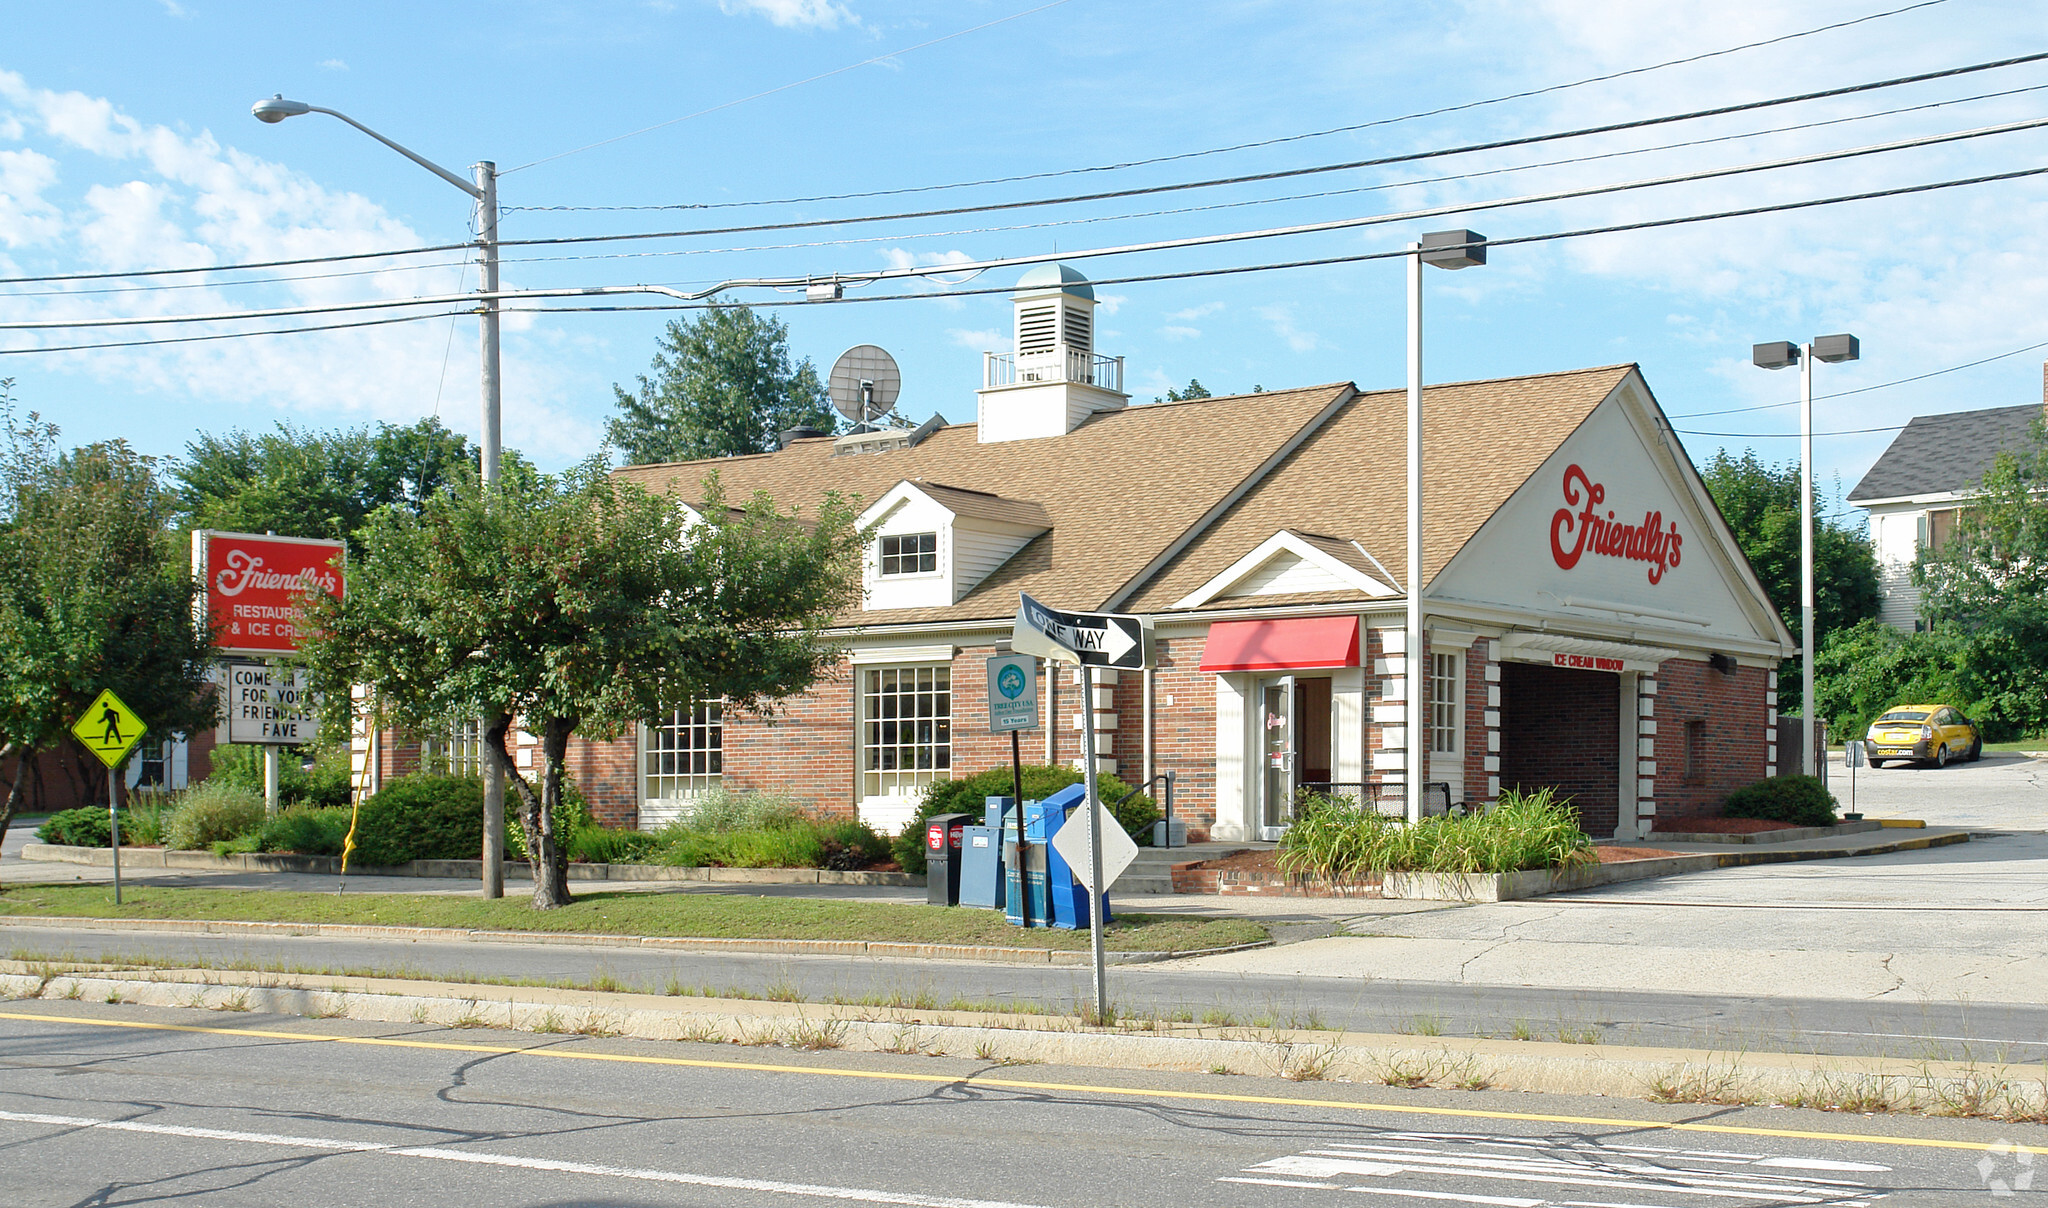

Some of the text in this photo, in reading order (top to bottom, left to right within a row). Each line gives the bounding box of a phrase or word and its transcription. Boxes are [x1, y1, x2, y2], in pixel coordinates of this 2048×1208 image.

[1550, 463, 1683, 585] Friendly's
[216, 549, 337, 601] Friendly's
[233, 604, 304, 620] RESTAURA
[231, 622, 241, 635] &
[248, 623, 270, 636] ICE
[1036, 612, 1105, 649] ONE WAY
[1554, 653, 1624, 671] ICE CREAM WINDOW
[236, 671, 271, 686] COME
[242, 688, 268, 703] FOR
[262, 723, 297, 737] FAVE
[1877, 749, 1914, 757] costar.com
